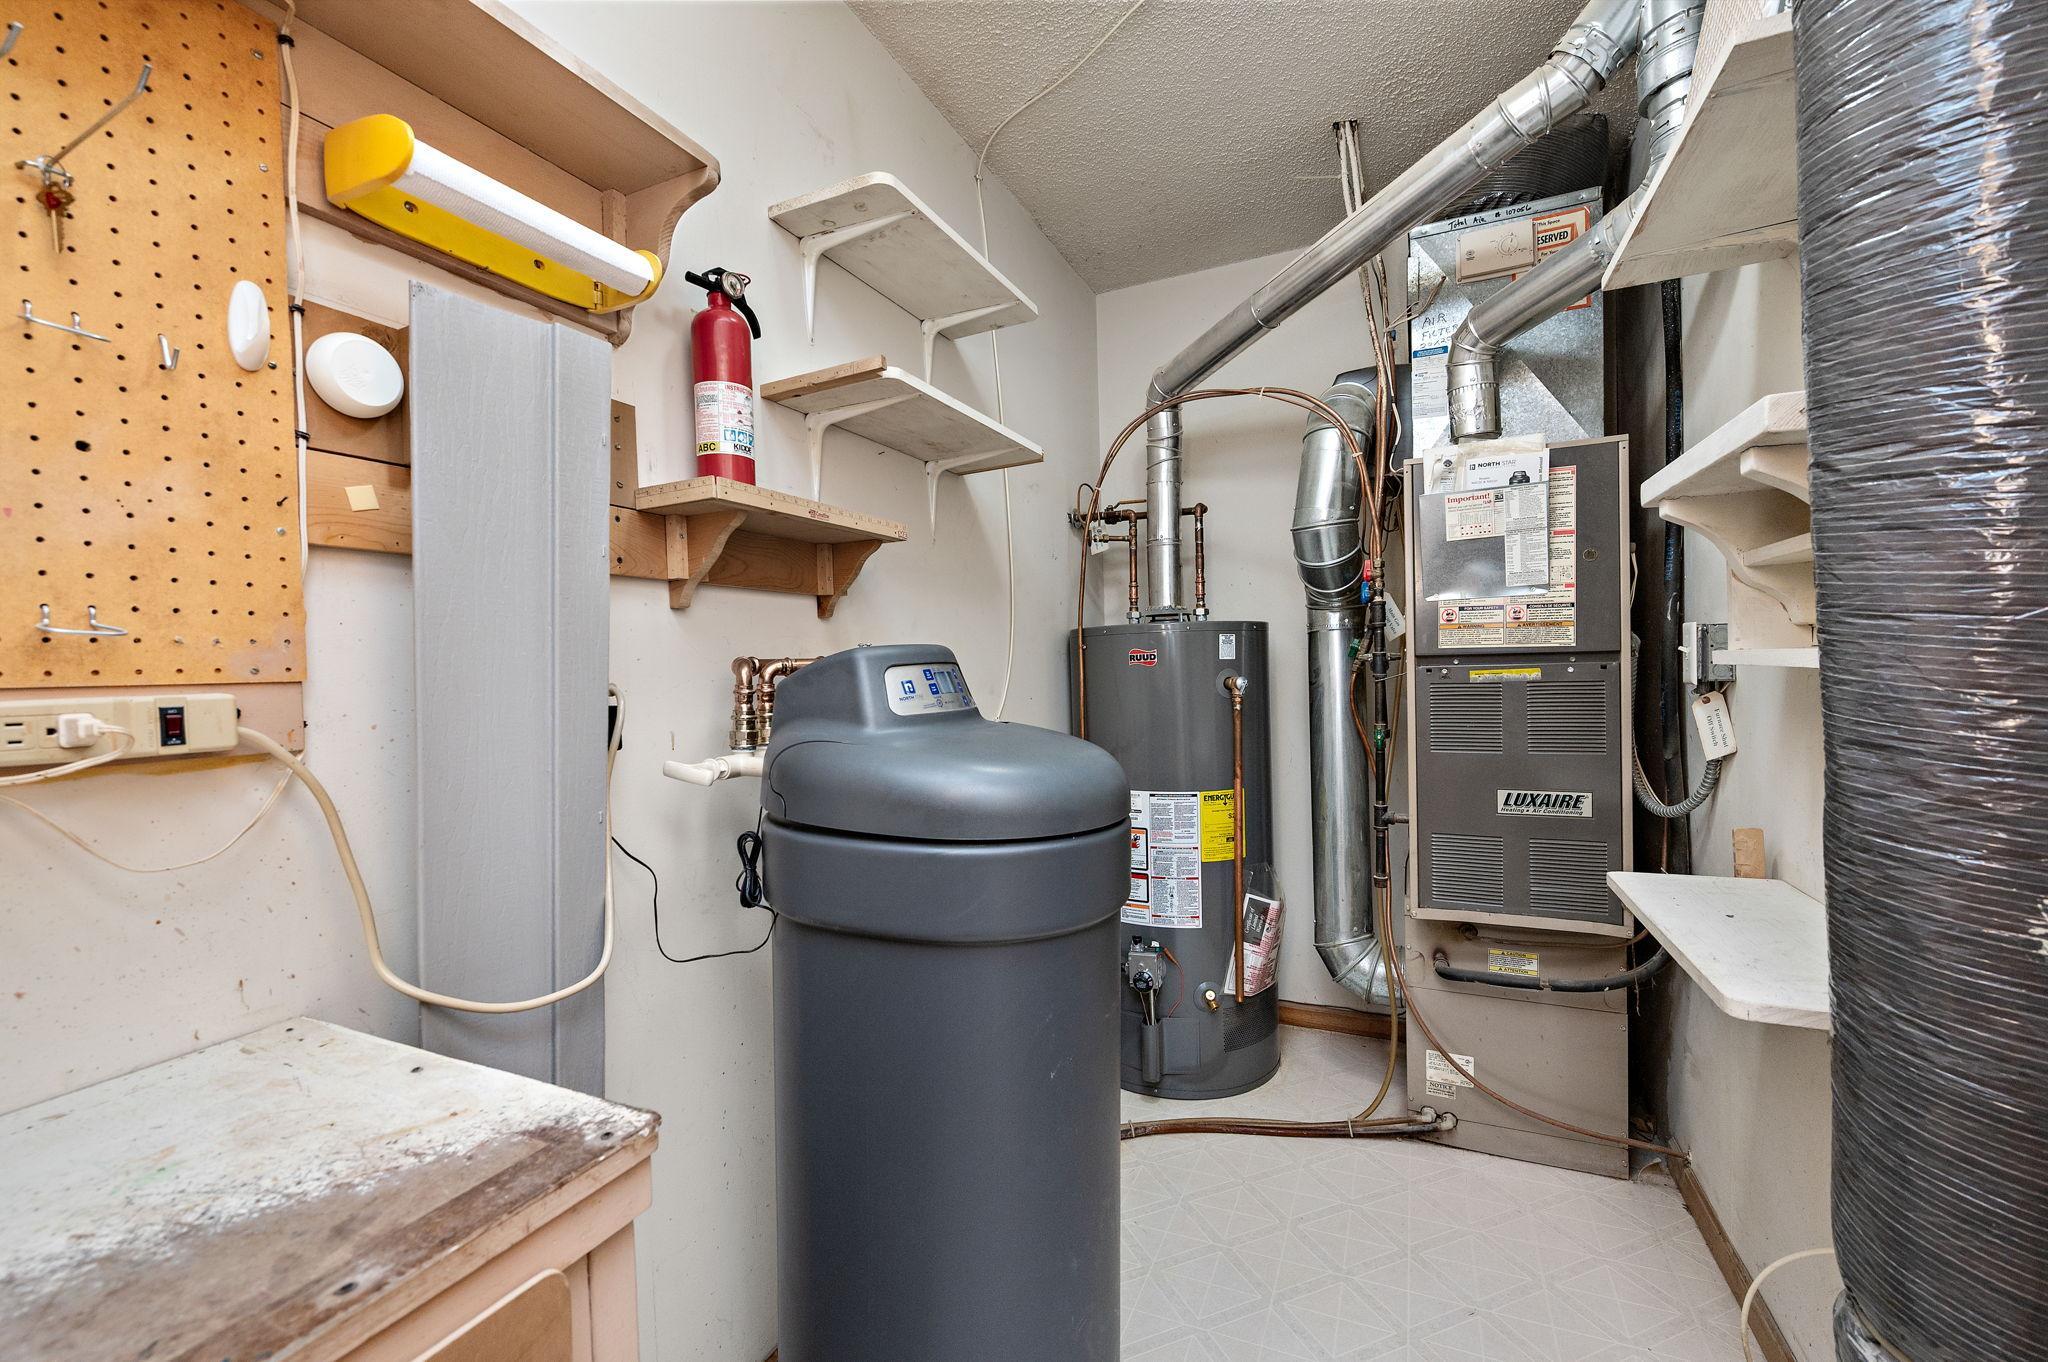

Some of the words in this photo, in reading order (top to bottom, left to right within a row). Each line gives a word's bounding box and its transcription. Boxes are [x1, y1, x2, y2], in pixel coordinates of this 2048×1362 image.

[1447, 218, 1468, 231] Total
[1472, 215, 1487, 225] Air
[1537, 230, 1569, 246] ESERVED
[1421, 312, 1447, 329] AIR
[1421, 324, 1459, 341] FILTER
[698, 442, 716, 453] ABC
[733, 443, 752, 453] KIDDE
[1477, 460, 1501, 468] NORTH
[1447, 492, 1490, 504] Important!
[1129, 653, 1157, 662] RUUD
[1706, 715, 1714, 726] Off
[1710, 726, 1719, 747] Switch
[1714, 708, 1723, 733] Furnace
[1721, 733, 1729, 748] Shut
[1204, 793, 1235, 801] ENERGYGU
[1503, 792, 1586, 810] LUXAIRE
[1429, 1081, 1453, 1090] NOTICE
